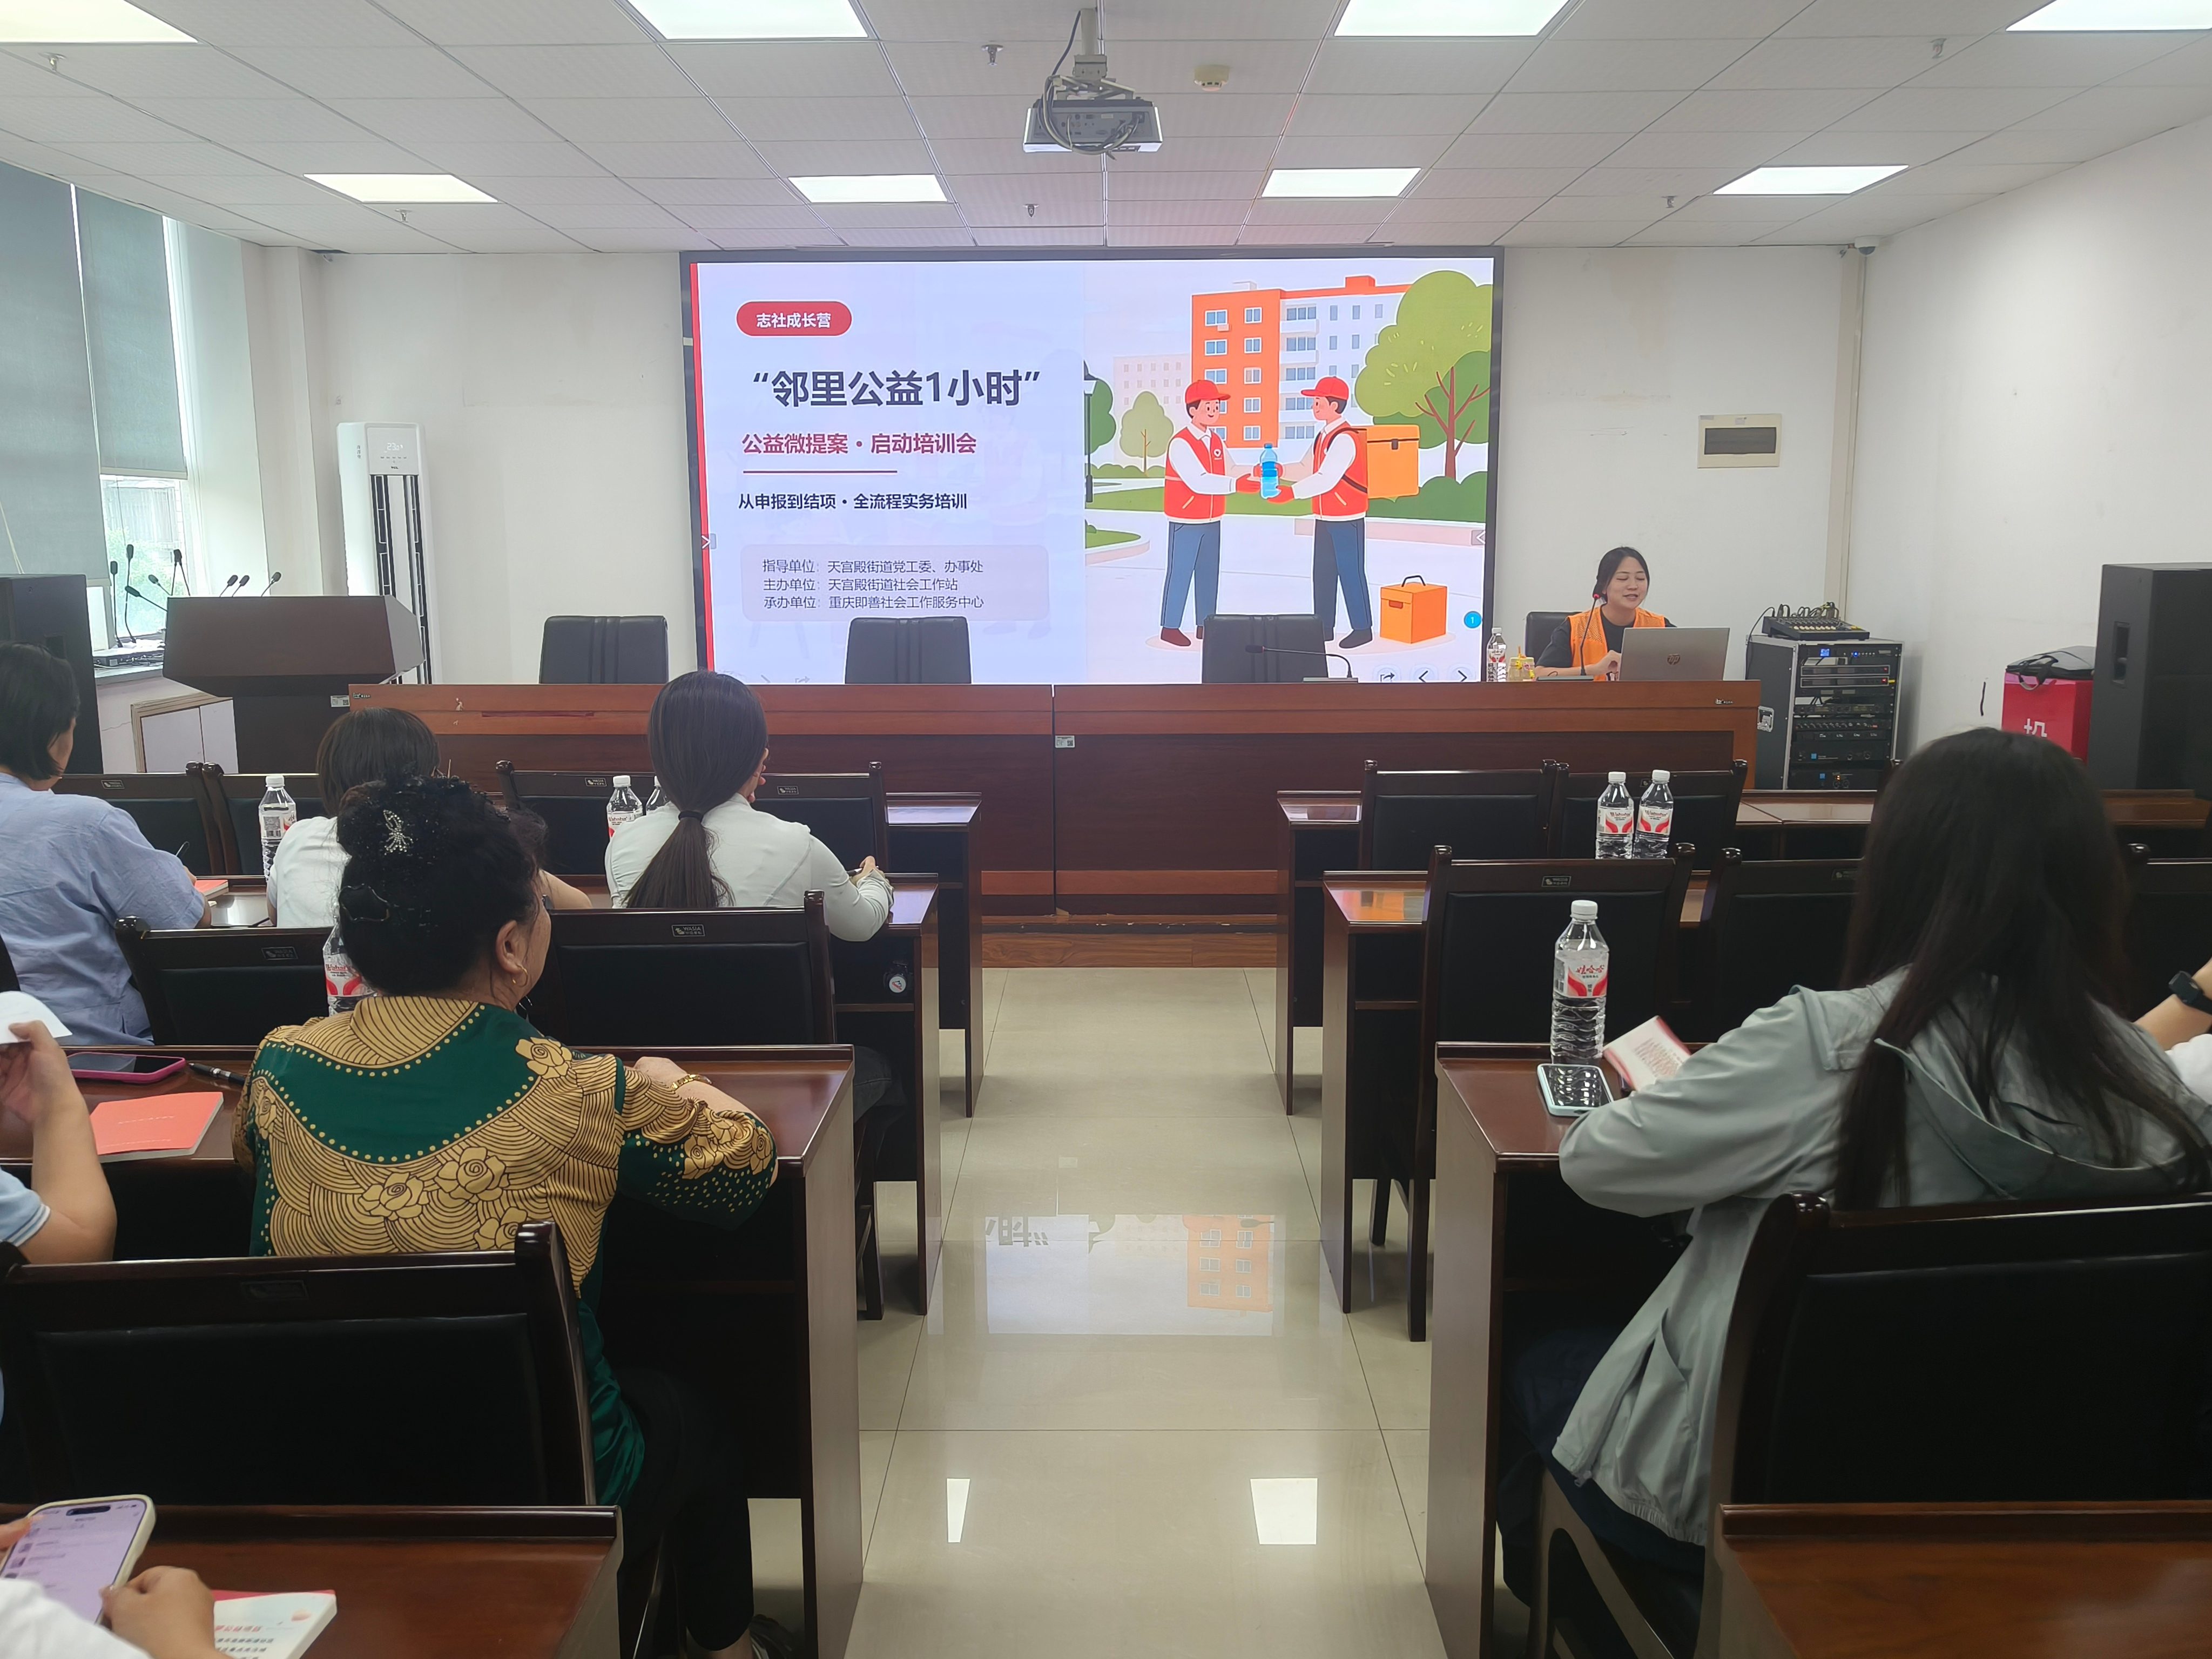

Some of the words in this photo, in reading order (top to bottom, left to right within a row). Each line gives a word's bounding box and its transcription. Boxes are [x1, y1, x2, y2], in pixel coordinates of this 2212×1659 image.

[756, 313, 831, 328] 志社成长营
[752, 369, 1041, 407] “邻里公益1小时”
